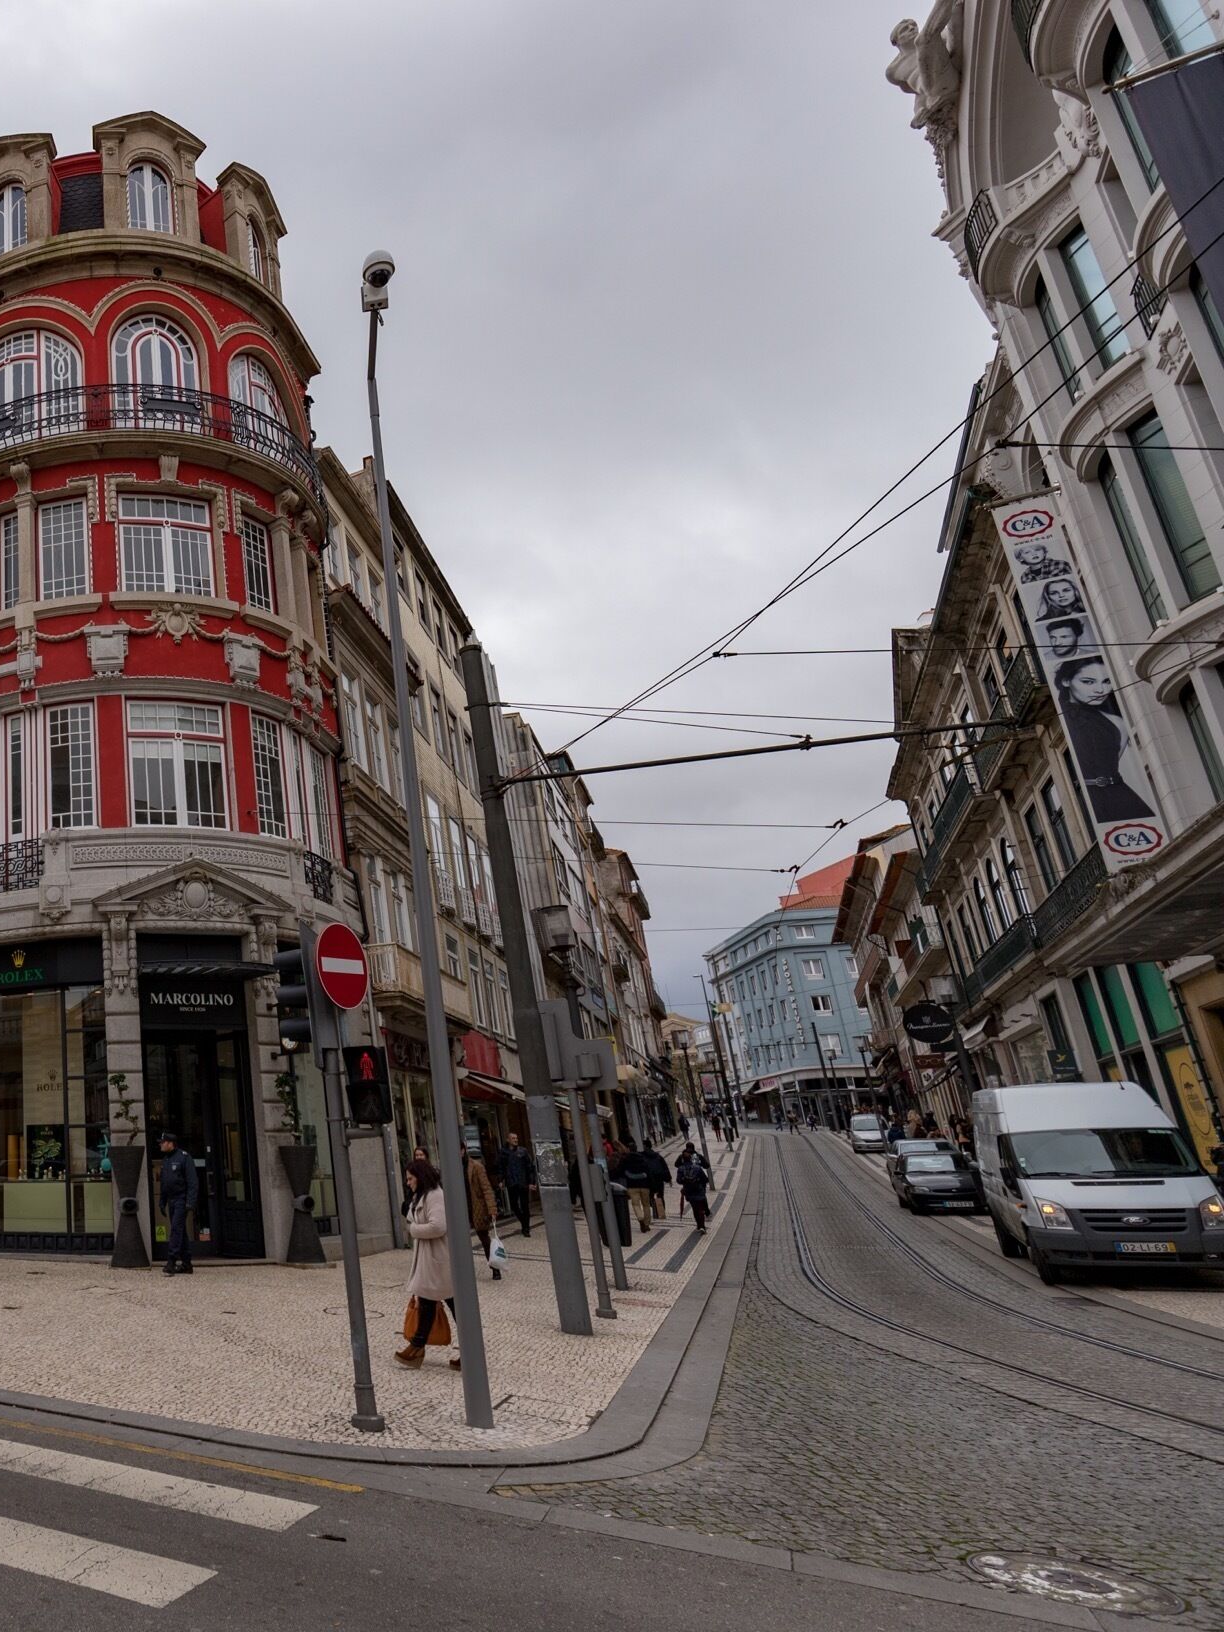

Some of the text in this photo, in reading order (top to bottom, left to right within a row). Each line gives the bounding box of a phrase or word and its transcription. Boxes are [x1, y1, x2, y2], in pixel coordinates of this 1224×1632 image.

[1011, 516, 1046, 531] C&A
[1114, 831, 1154, 847] C&A
[150, 992, 234, 1006] MARCOLINO
[37, 1083, 63, 1092] ROLE
